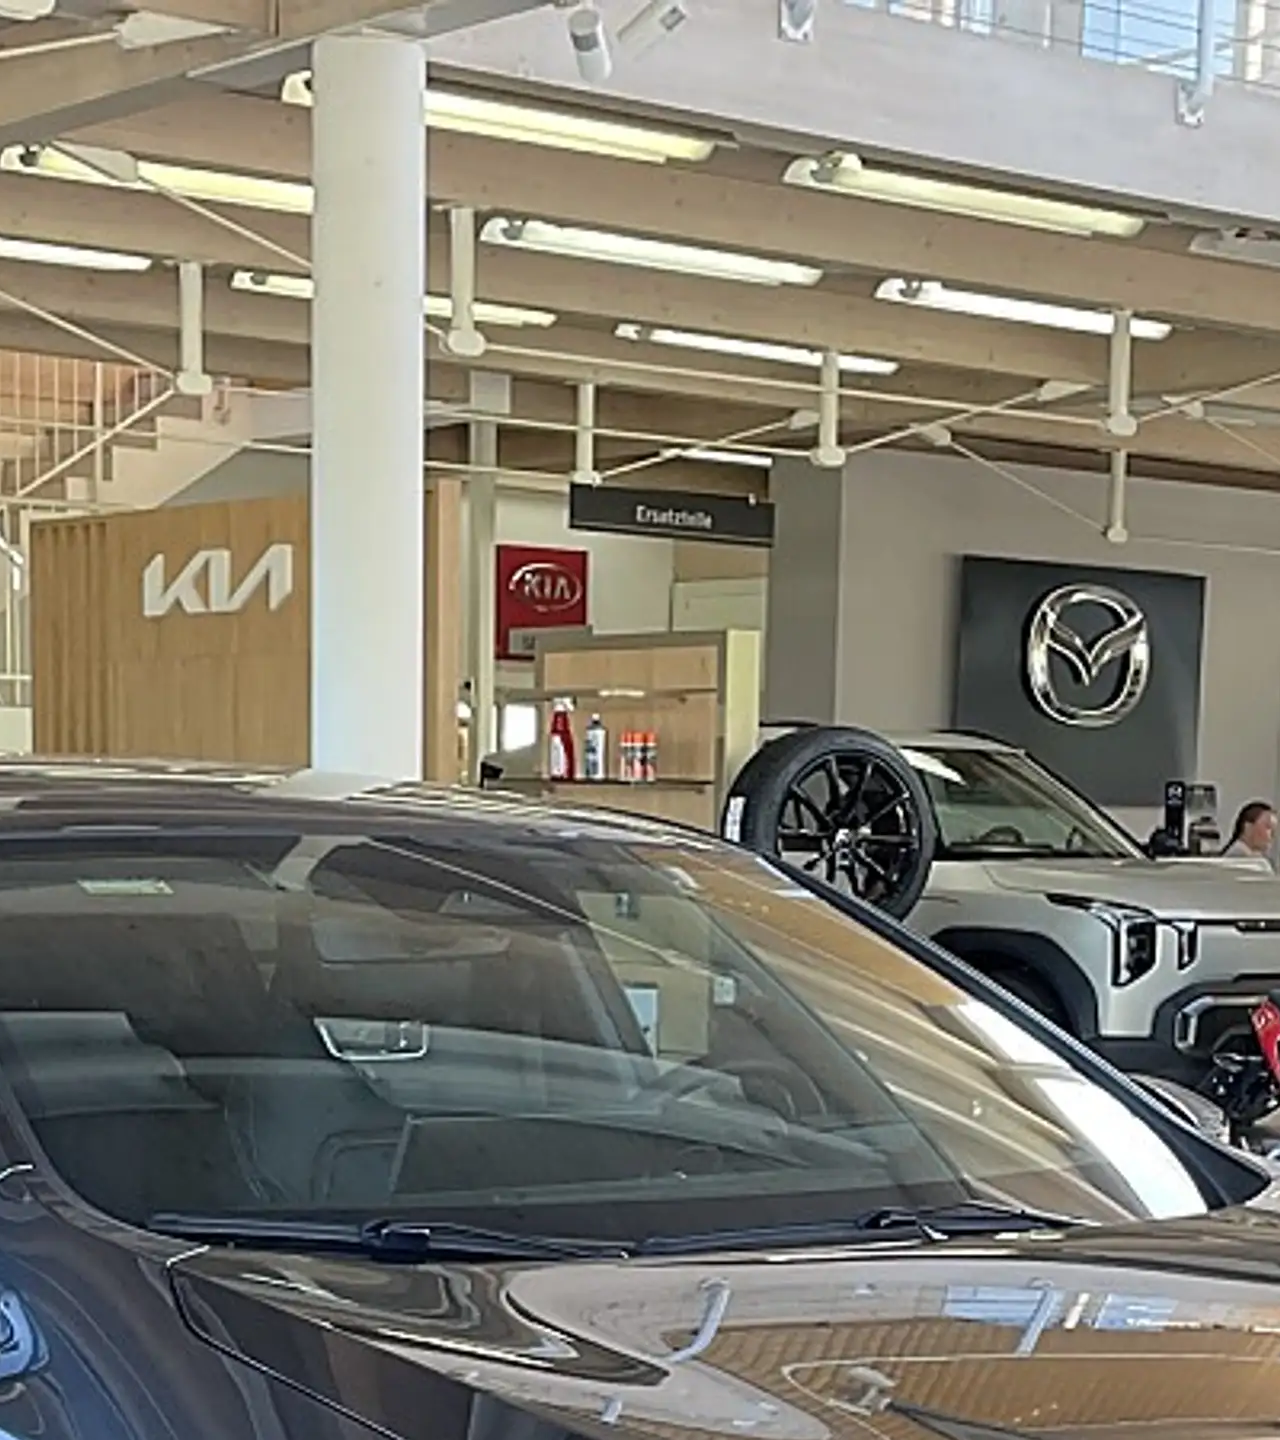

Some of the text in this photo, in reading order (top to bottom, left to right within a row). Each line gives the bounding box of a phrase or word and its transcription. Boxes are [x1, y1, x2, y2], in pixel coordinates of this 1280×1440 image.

[634, 504, 714, 530] Ersatzteile
[142, 542, 294, 618] KIA
[523, 571, 571, 601] KIA
